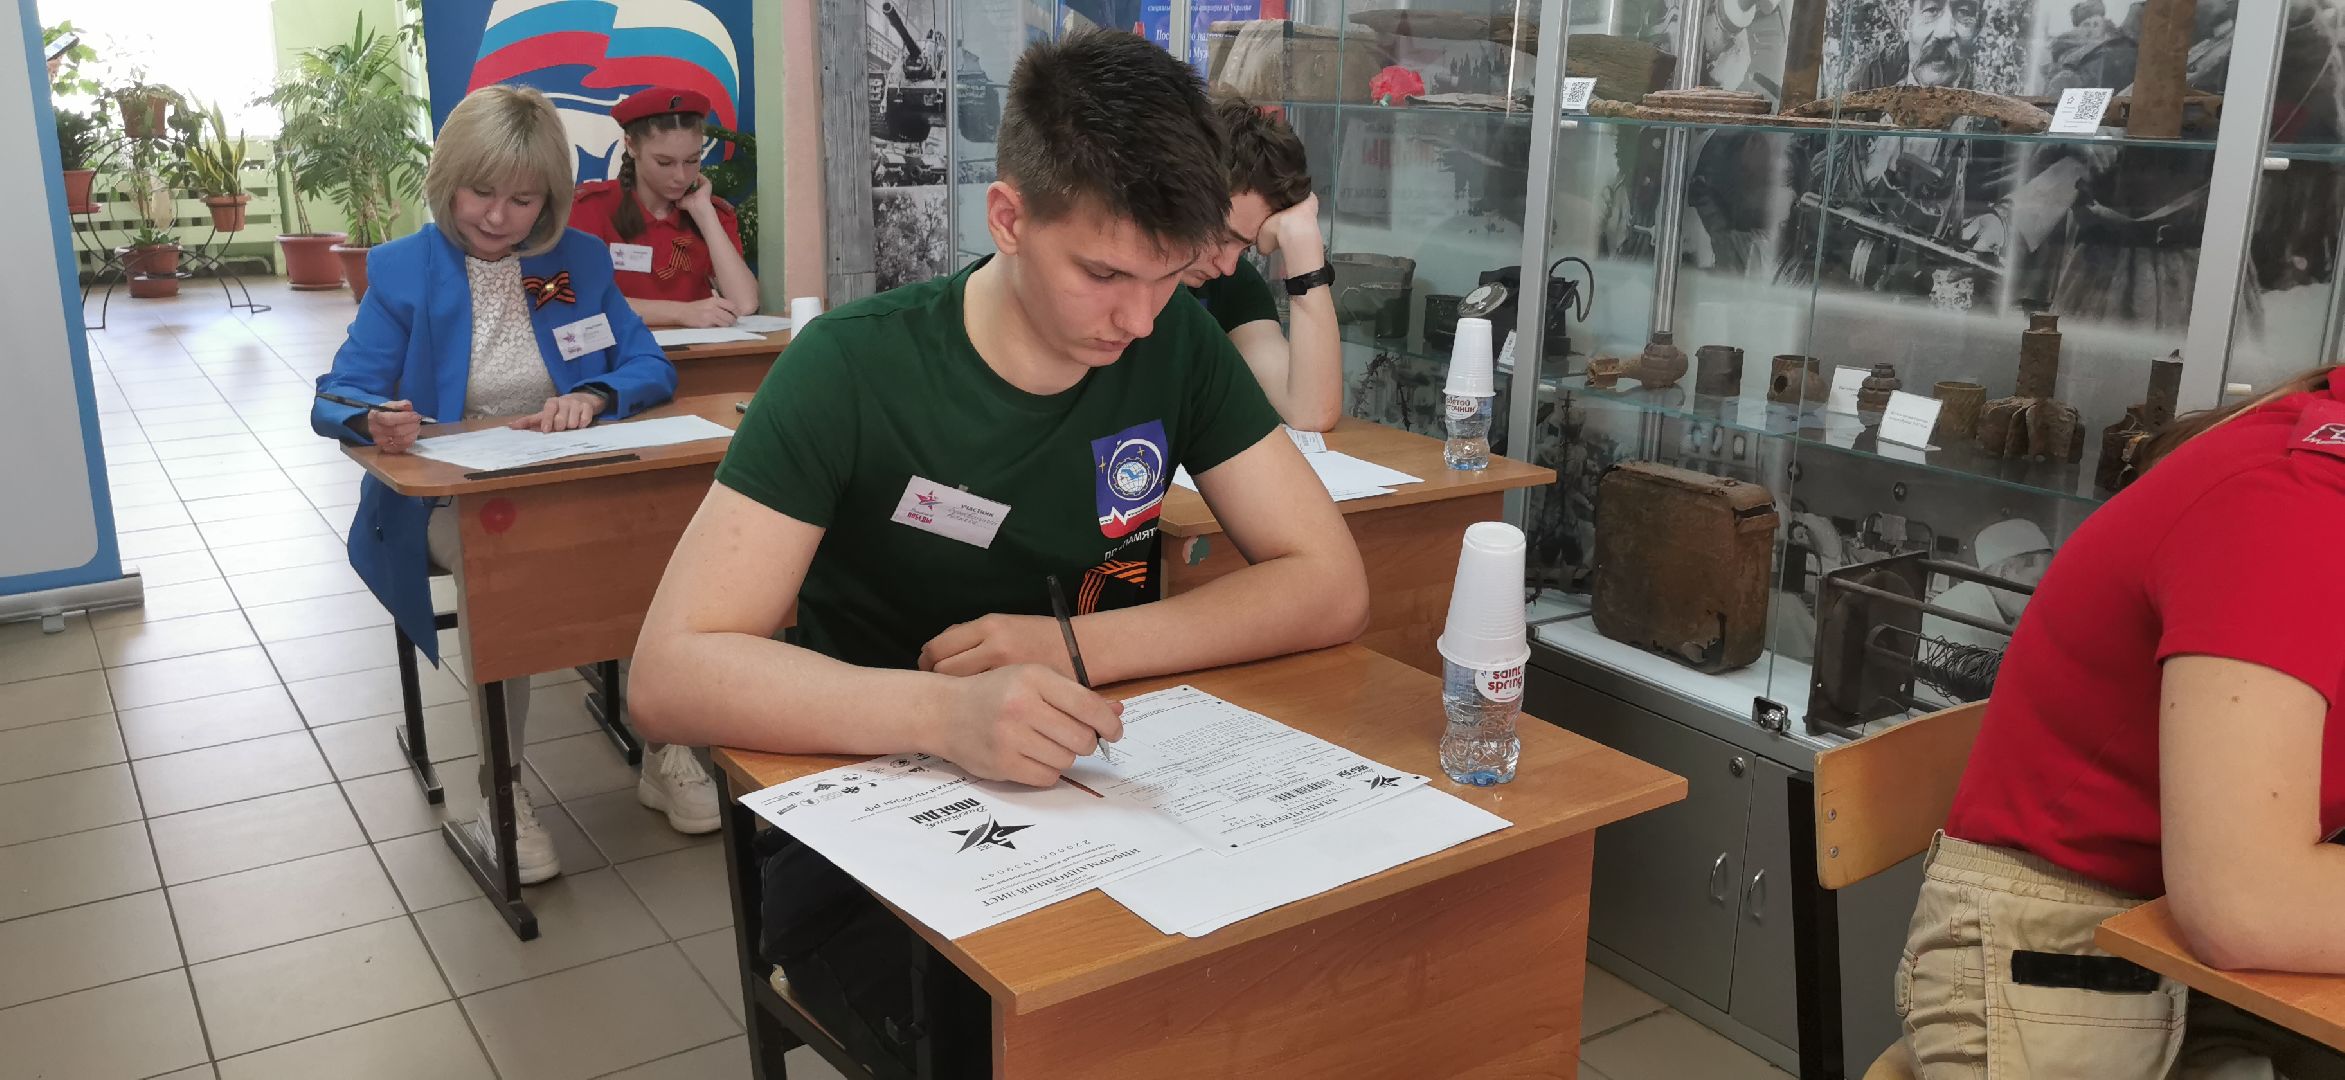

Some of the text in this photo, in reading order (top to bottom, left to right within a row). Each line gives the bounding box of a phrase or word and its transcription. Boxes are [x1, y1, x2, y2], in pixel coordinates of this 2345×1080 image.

[1487, 676, 1523, 693] spring
[908, 797, 981, 825] ПОБЕДЫ
[1018, 848, 1141, 897] ИНФОРМАЦИОННЫЙ
[981, 890, 1018, 907] ЛИСТ
